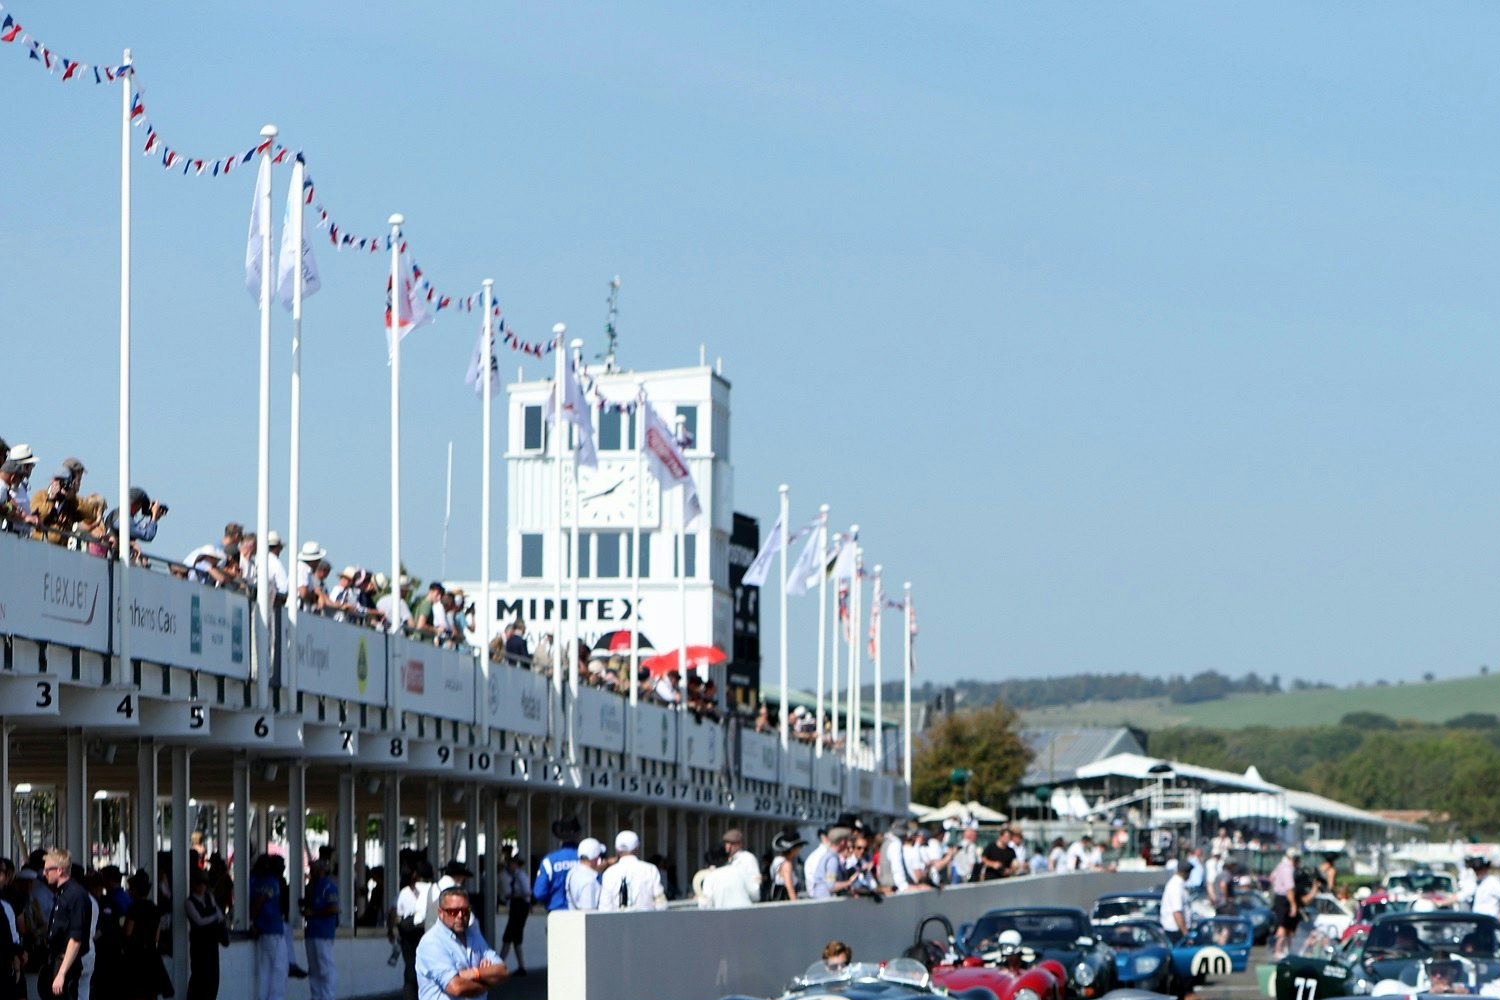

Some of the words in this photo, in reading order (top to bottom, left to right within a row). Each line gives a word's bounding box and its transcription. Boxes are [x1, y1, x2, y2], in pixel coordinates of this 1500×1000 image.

[158, 606, 177, 635] Cars
[36, 682, 52, 707] 3
[116, 693, 134, 719] 4
[189, 705, 204, 729] 5
[254, 716, 269, 738] 6
[340, 730, 352, 750] 7
[390, 737, 403, 758] 8
[437, 745, 450, 765] 9
[469, 752, 491, 771] 10
[590, 771, 609, 788] 14
[621, 776, 638, 793] 15
[646, 781, 664, 797] 16
[672, 784, 689, 799] 17
[696, 786, 713, 802] 18
[754, 797, 772, 812] 20
[1197, 956, 1227, 977] 40
